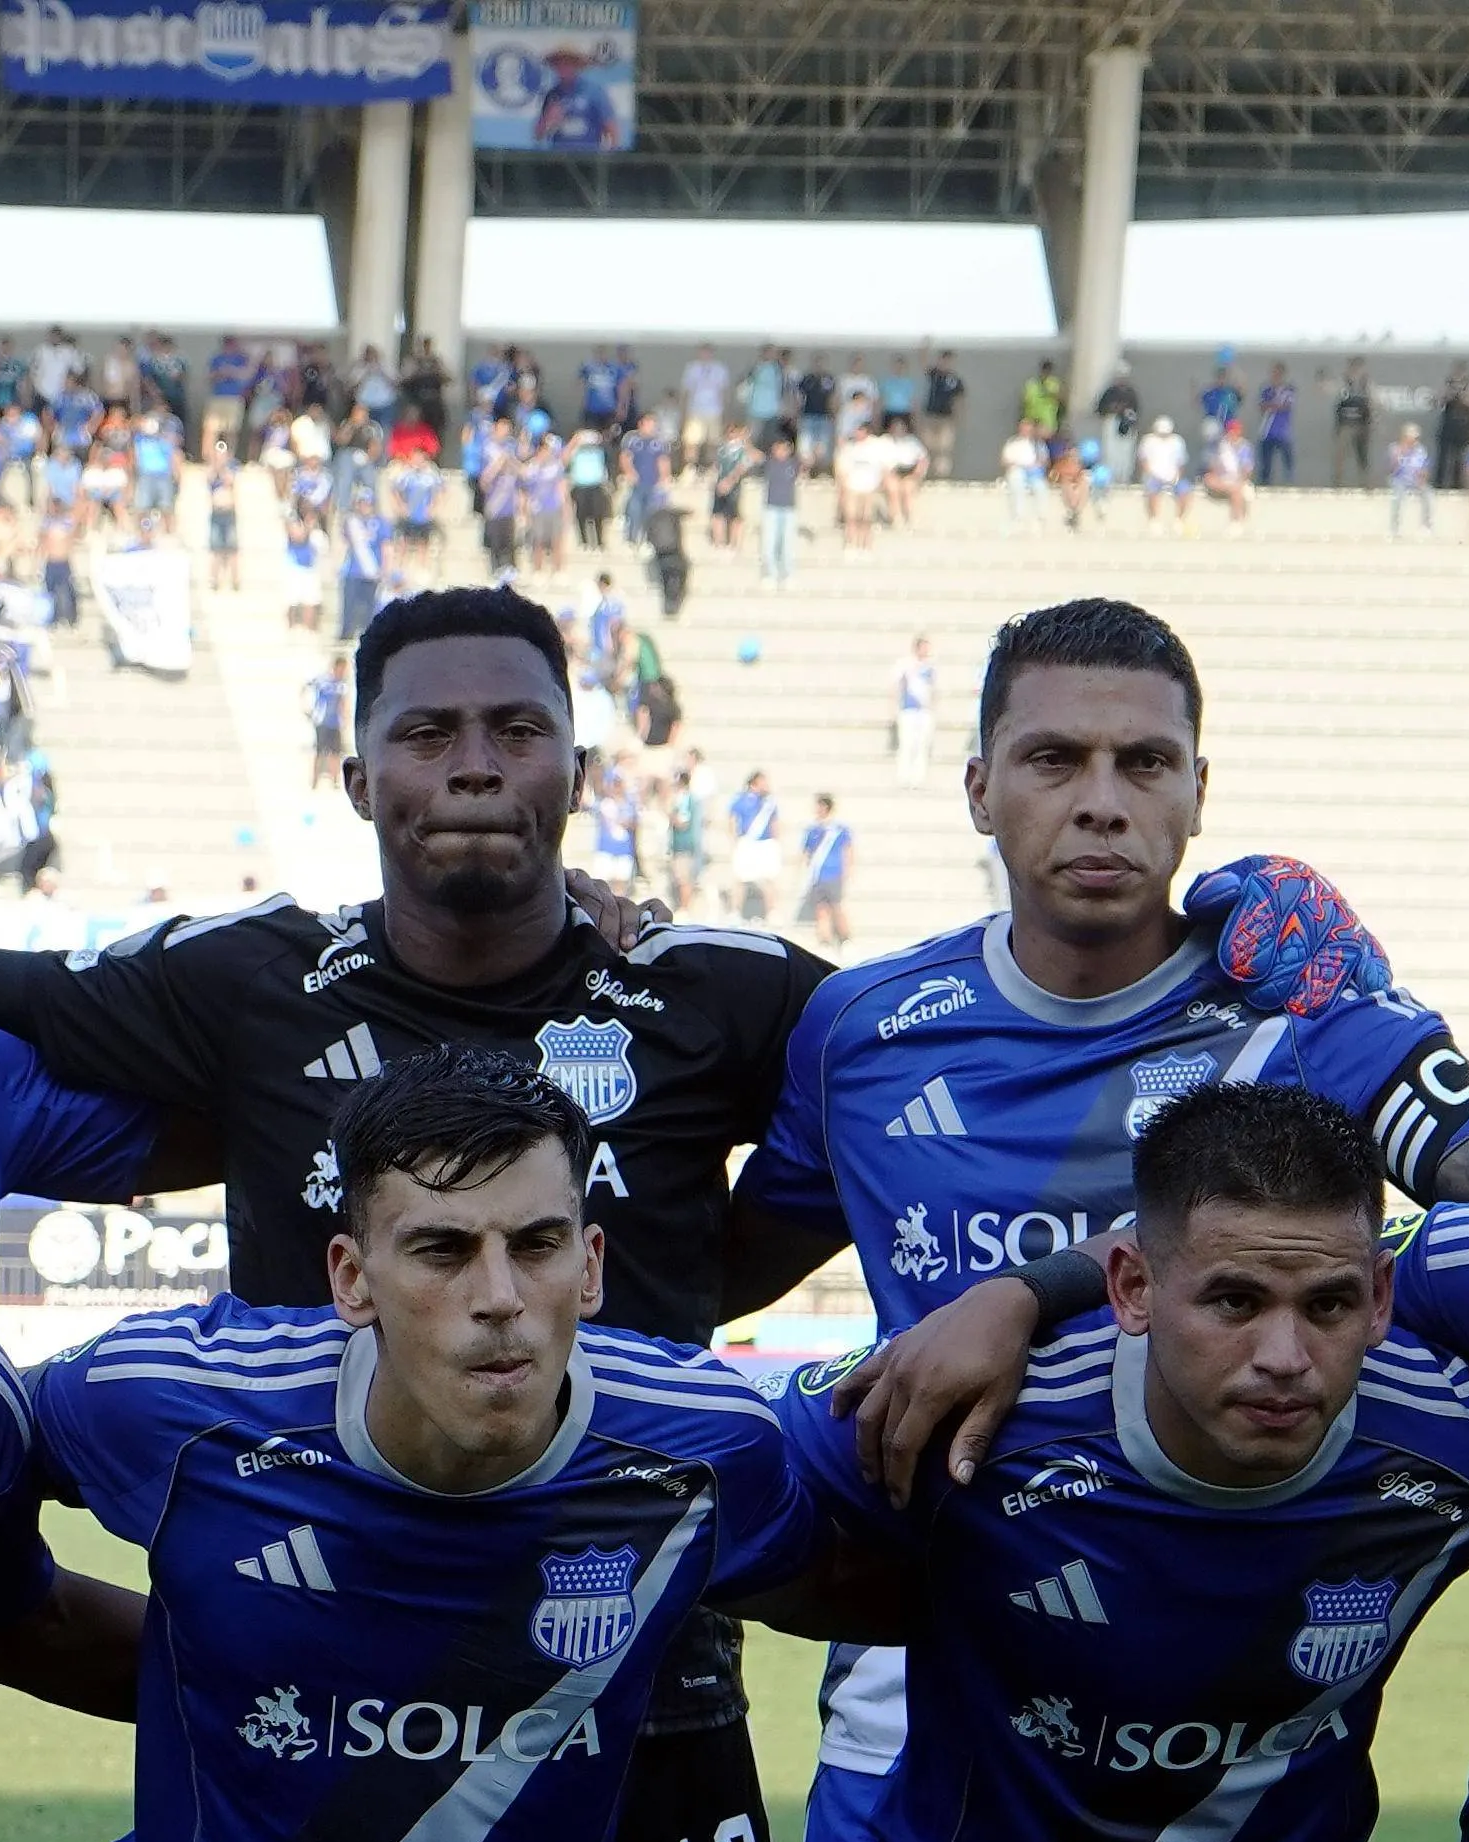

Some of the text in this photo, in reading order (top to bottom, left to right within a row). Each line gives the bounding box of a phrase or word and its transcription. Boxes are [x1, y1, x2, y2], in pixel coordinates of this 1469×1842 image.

[877, 983, 978, 1041] Electrolit
[1001, 1472, 1115, 1517] Electrolit
[1377, 1471, 1464, 1522] Splendor
[534, 1596, 631, 1664] EMELEC
[1292, 1622, 1388, 1683] EMELEC
[343, 1698, 602, 1763] SOLCA
[1109, 1706, 1350, 1773] SOLCA
